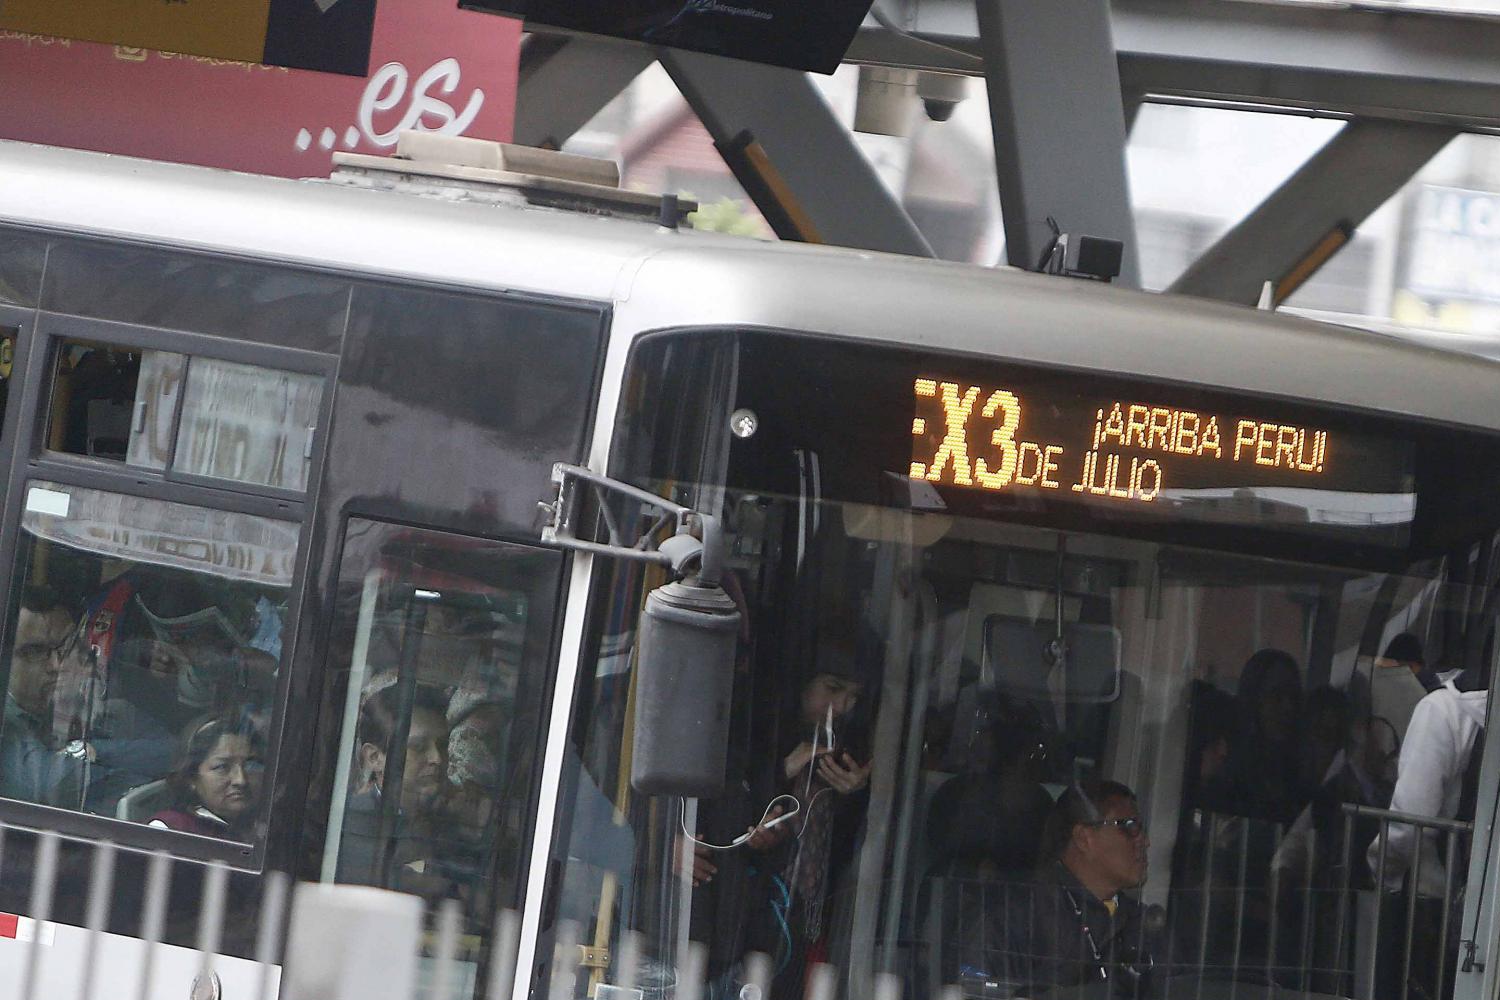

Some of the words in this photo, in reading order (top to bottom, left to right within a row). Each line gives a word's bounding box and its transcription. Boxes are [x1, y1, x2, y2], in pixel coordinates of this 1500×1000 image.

[1015, 442, 1064, 488] DE
[1072, 450, 1162, 501] JULIO
[1234, 419, 1327, 473] PERU!
